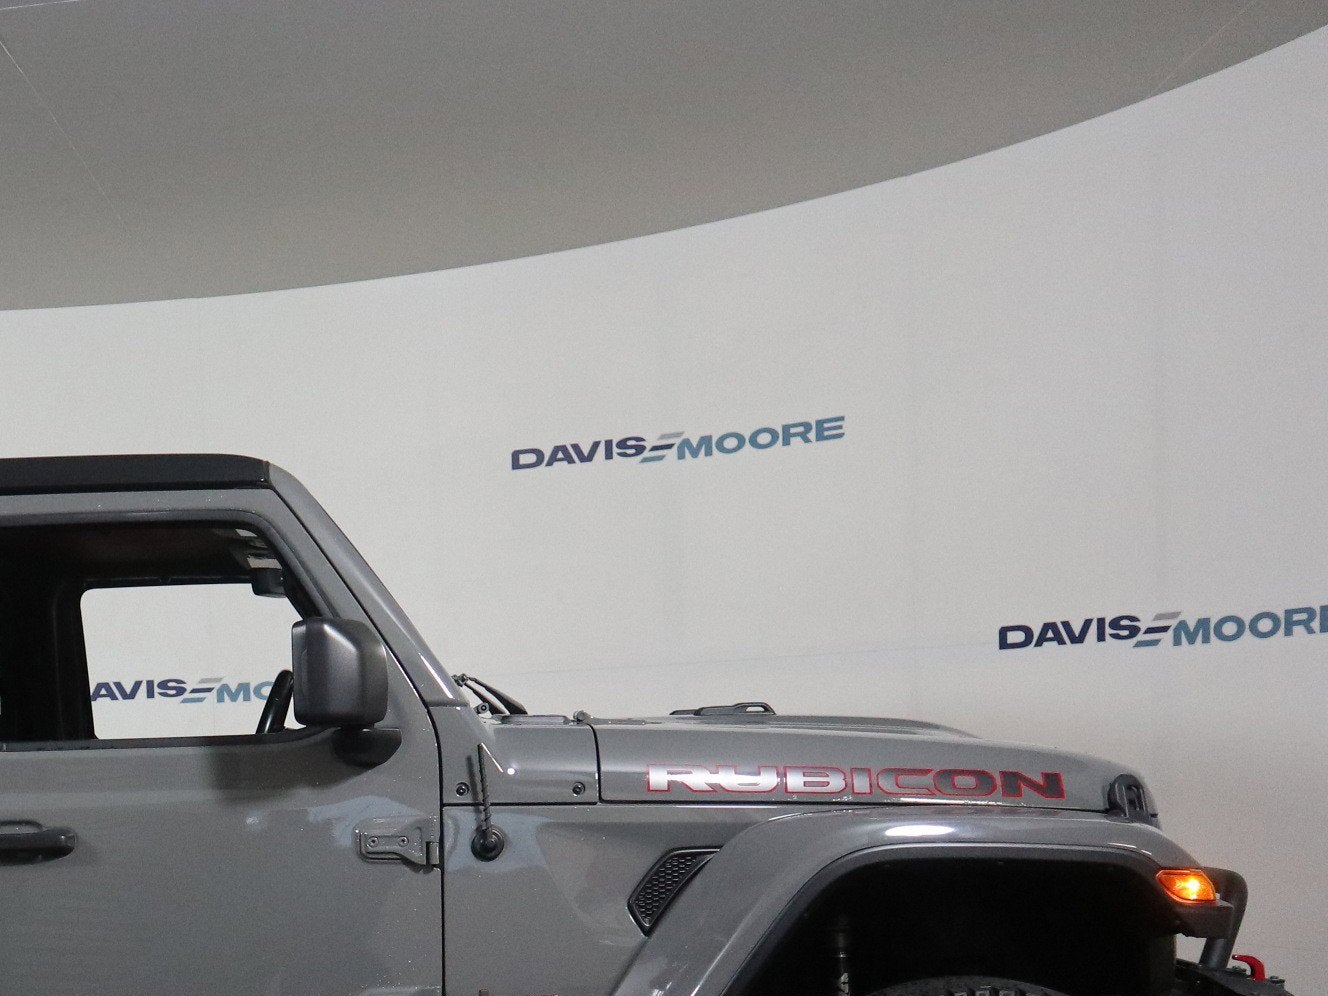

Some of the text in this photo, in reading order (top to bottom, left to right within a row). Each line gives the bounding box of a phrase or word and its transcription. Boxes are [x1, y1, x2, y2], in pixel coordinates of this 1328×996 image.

[510, 415, 846, 471] DAVIS MOORE
[998, 614, 1142, 650] DAVIS
[646, 763, 1066, 799] RUBICON
